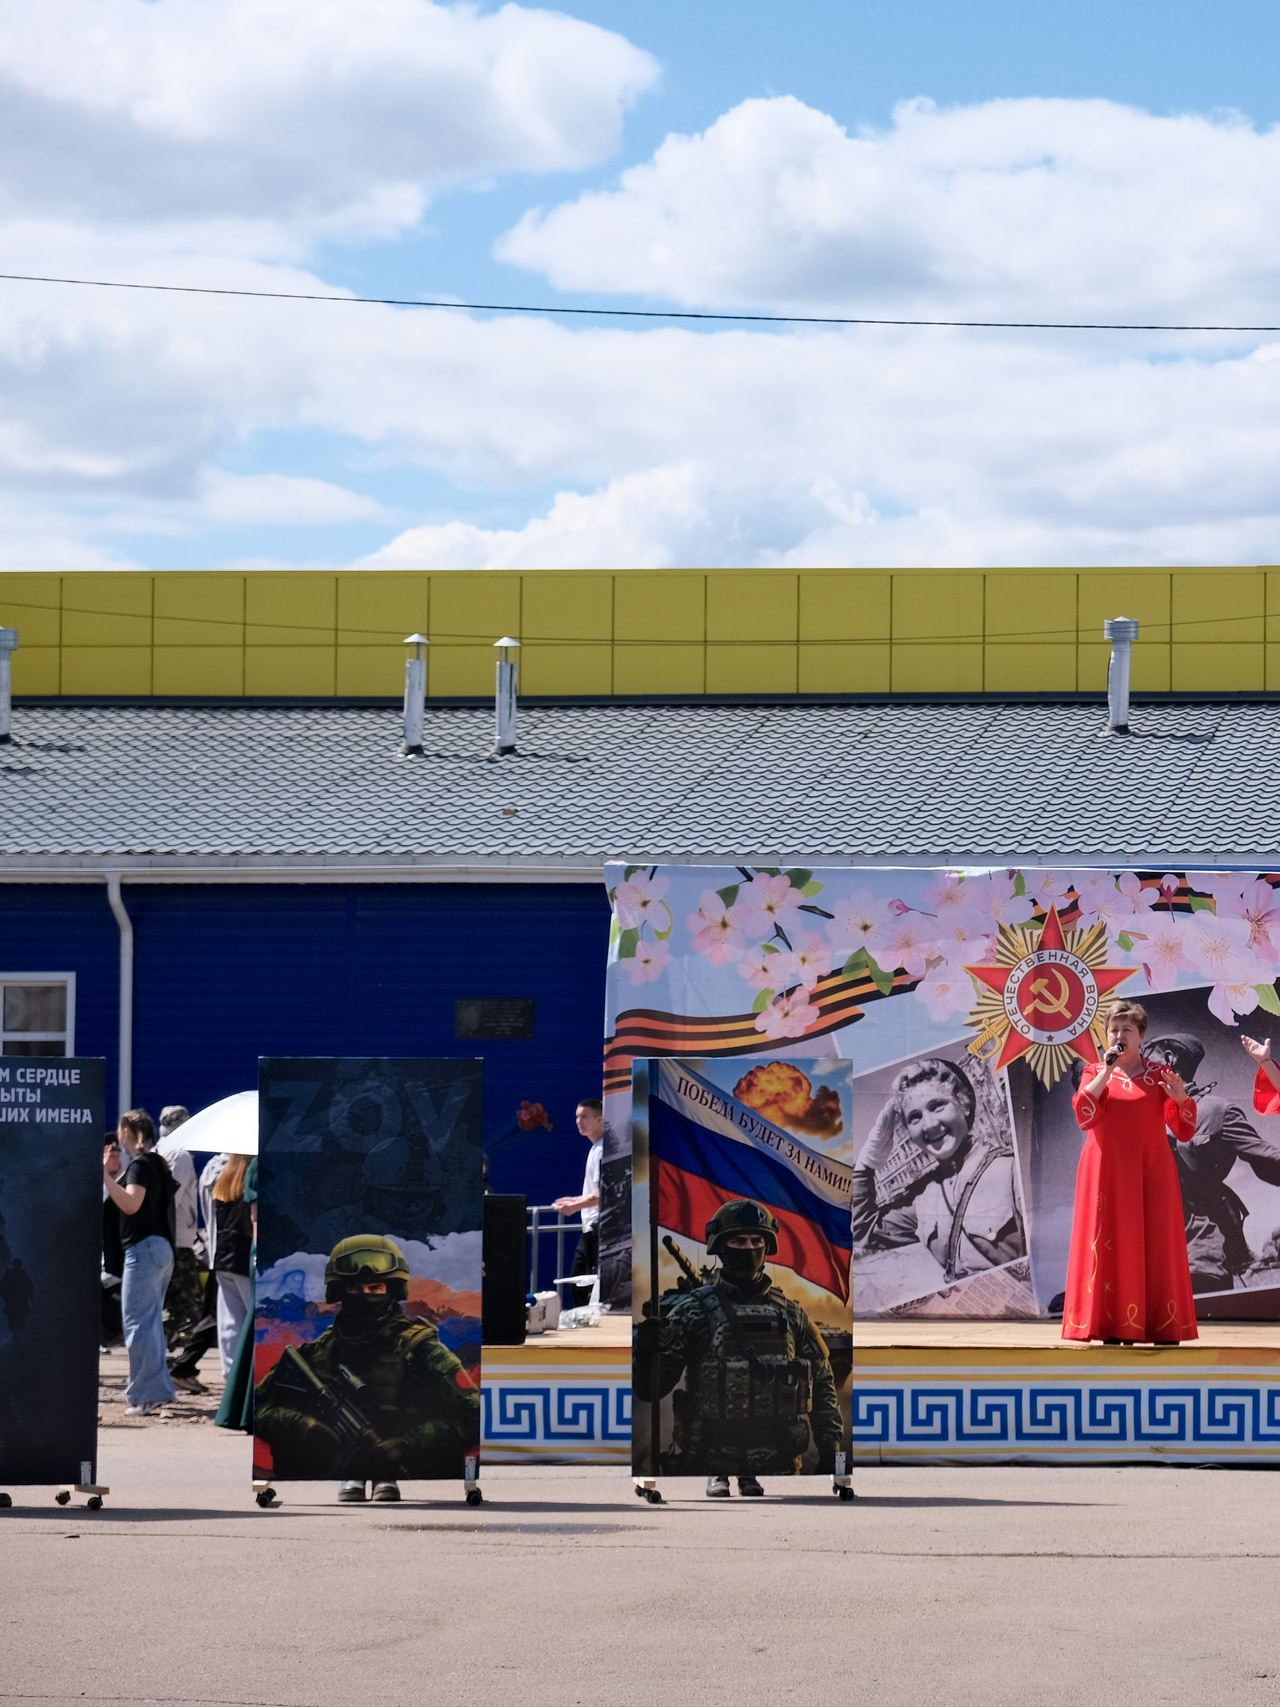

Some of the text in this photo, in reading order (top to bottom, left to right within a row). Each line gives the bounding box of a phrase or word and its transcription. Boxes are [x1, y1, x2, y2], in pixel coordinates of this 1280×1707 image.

[1006, 951, 1089, 1035] ОТЕЧЕСТВЕННАЯ
[16, 1067, 81, 1087] СЕРДЦЕ
[35, 1107, 93, 1124] ИМЕНА
[676, 1075, 852, 1194] ПОБЕДА БУДЕТ ЗА НАМИ!!
